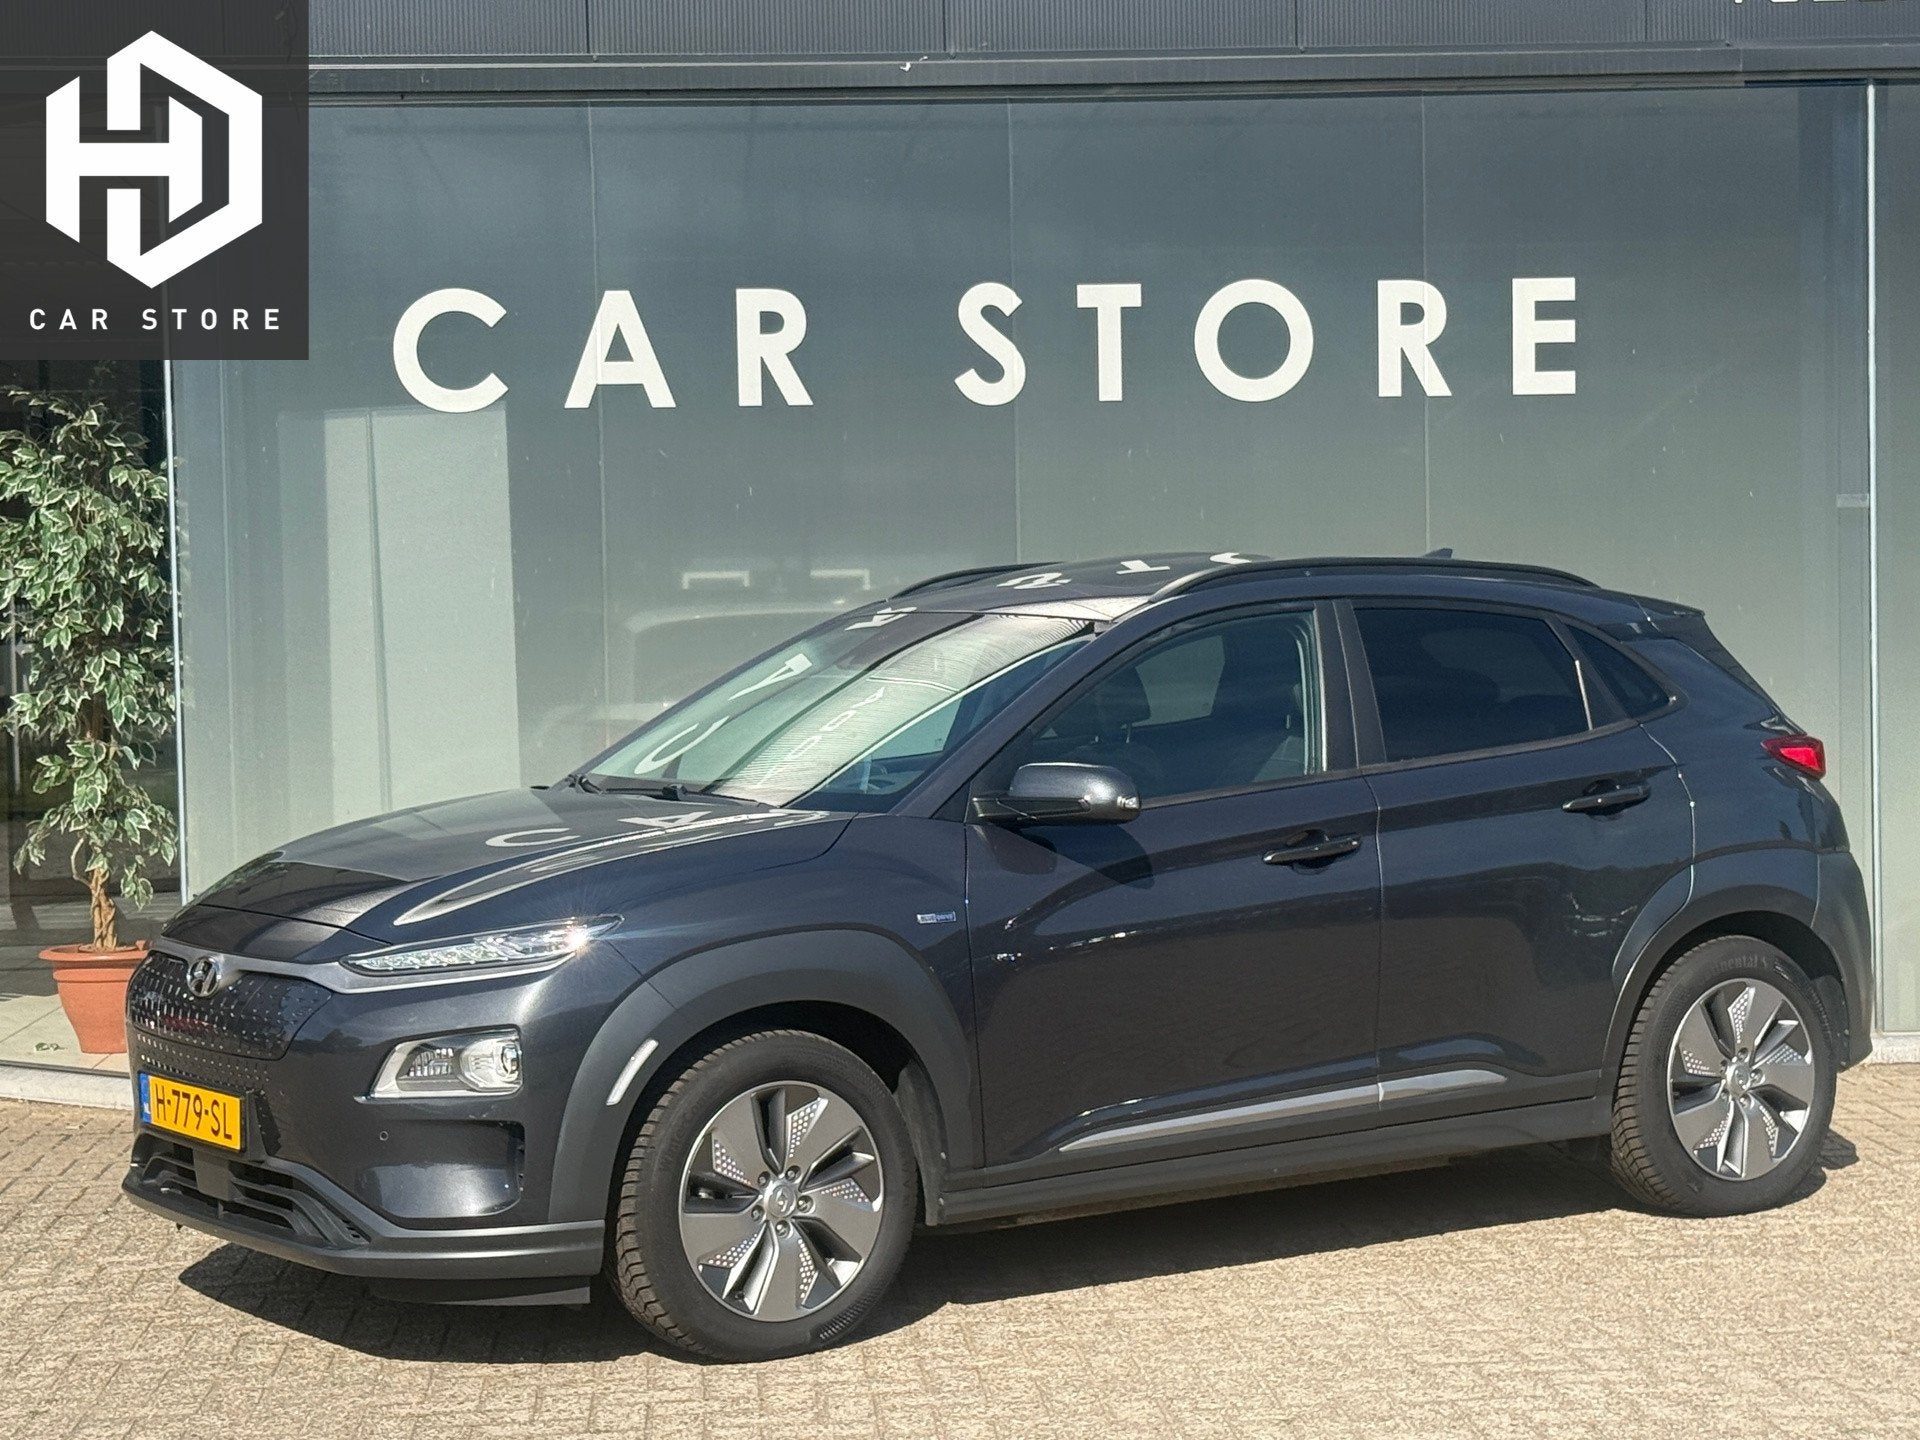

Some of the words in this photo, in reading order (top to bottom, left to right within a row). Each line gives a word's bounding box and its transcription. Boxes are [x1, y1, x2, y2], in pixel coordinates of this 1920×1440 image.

[393, 288, 814, 412] CAR
[954, 277, 1576, 406] STORE
[155, 1083, 233, 1140] H-779-SL
